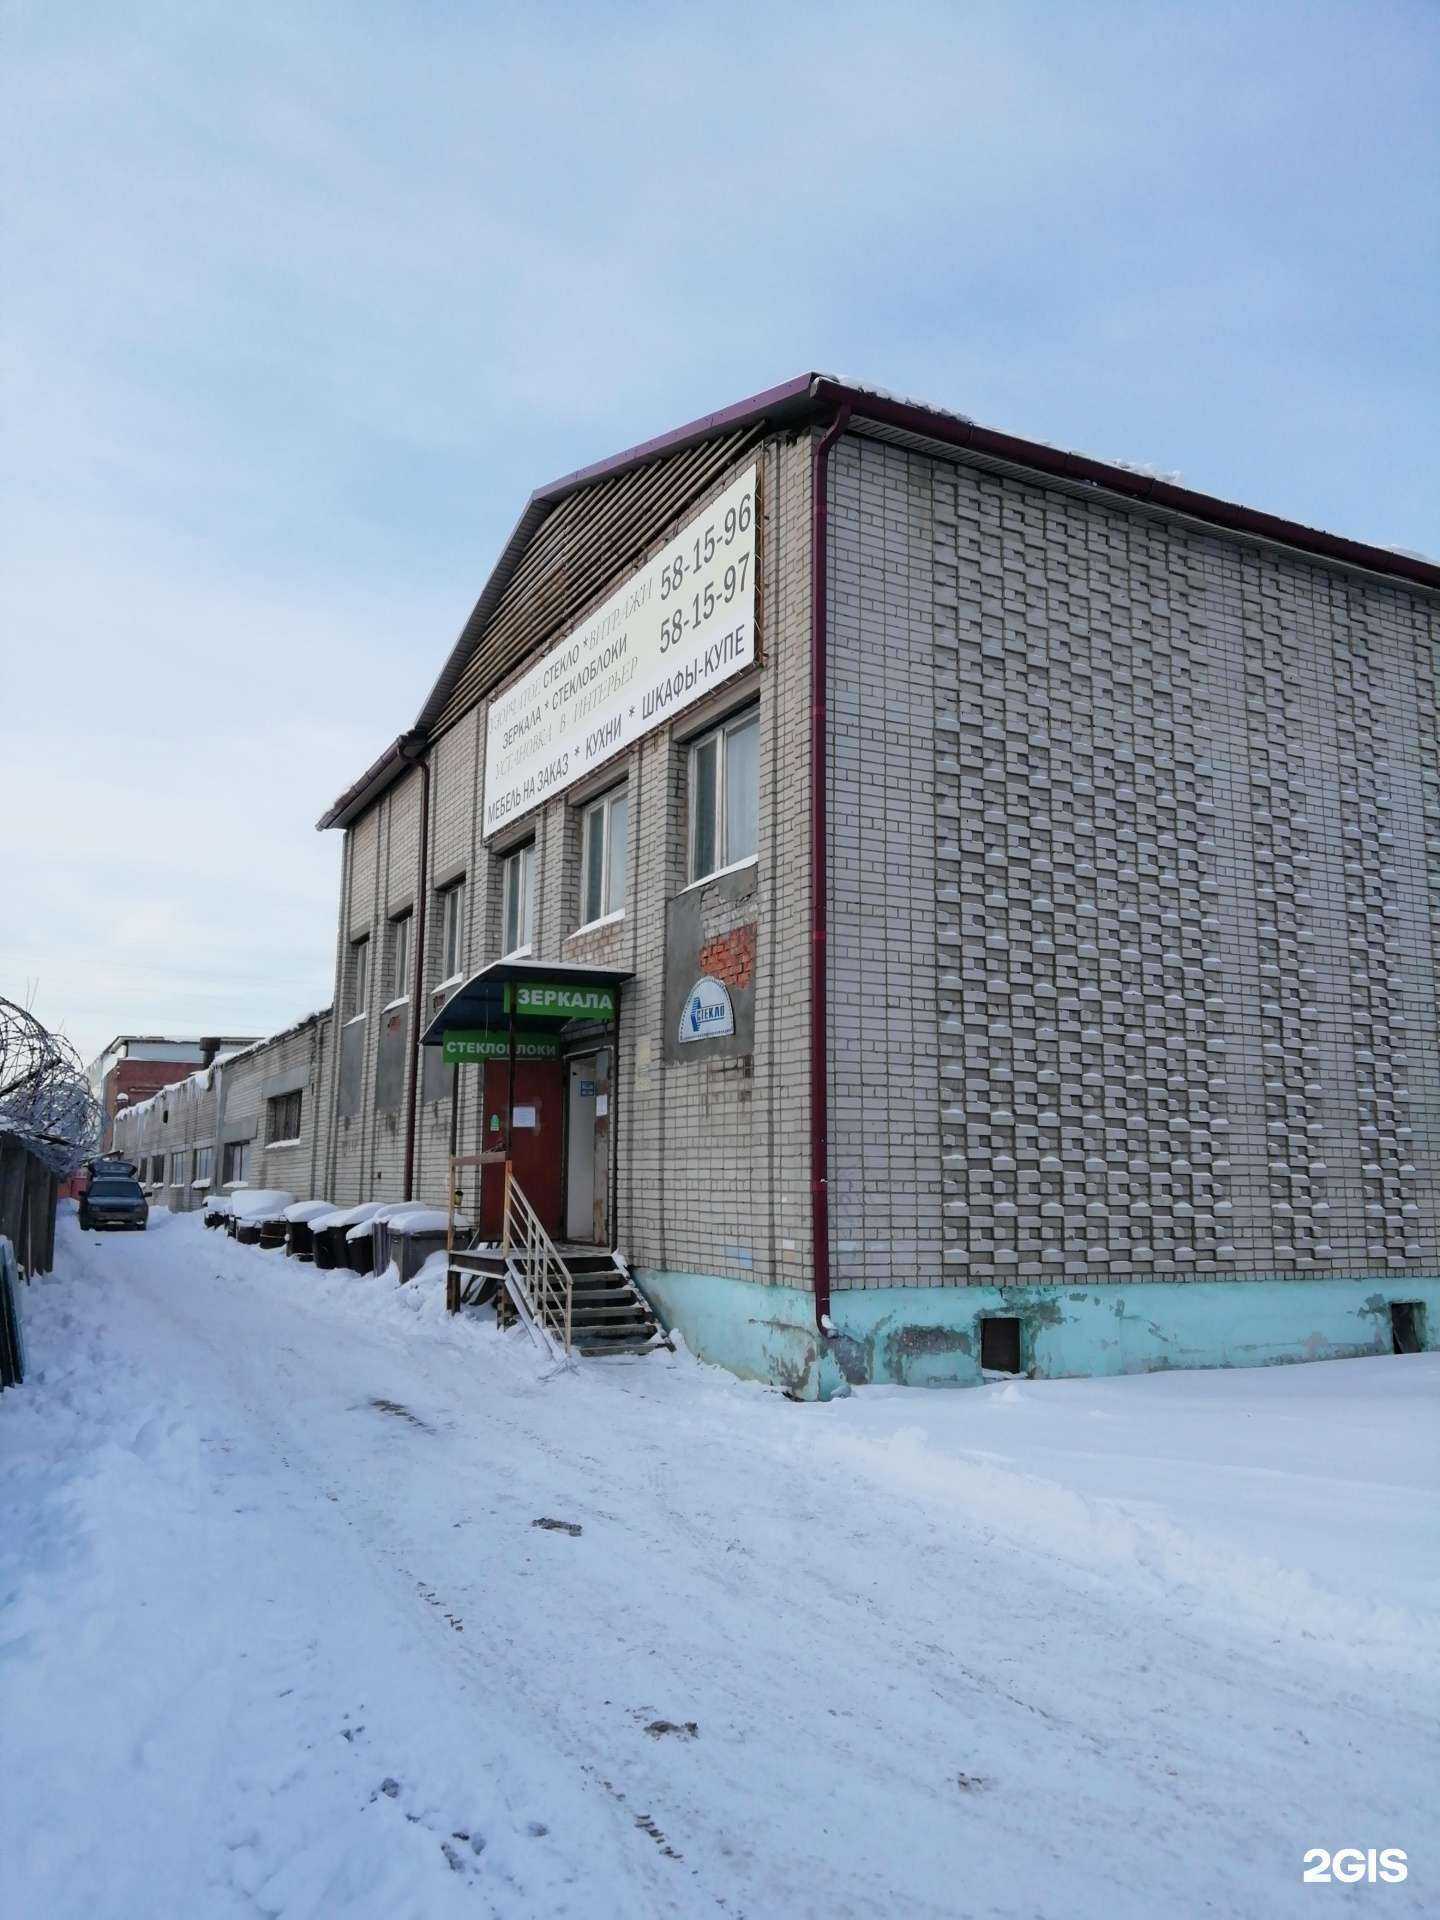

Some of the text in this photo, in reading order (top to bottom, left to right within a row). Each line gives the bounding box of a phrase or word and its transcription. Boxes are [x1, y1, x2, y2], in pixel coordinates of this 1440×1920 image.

[661, 493, 751, 600] 58-15-96
[660, 552, 750, 653] 58-15-97
[502, 633, 627, 750] ЗЕРКАЛА СТЕКЛОБЛОКИ
[543, 644, 580, 689] СТЕКЛО
[487, 624, 745, 825] МЕБЕЛЬ НА ЗАКАЗ КУХНИ ШКАФЫ-КУПЕ
[446, 1041, 556, 1056] СТЕКЛОЛОКИ
[518, 988, 613, 1010] ЗЕРКАЛА
